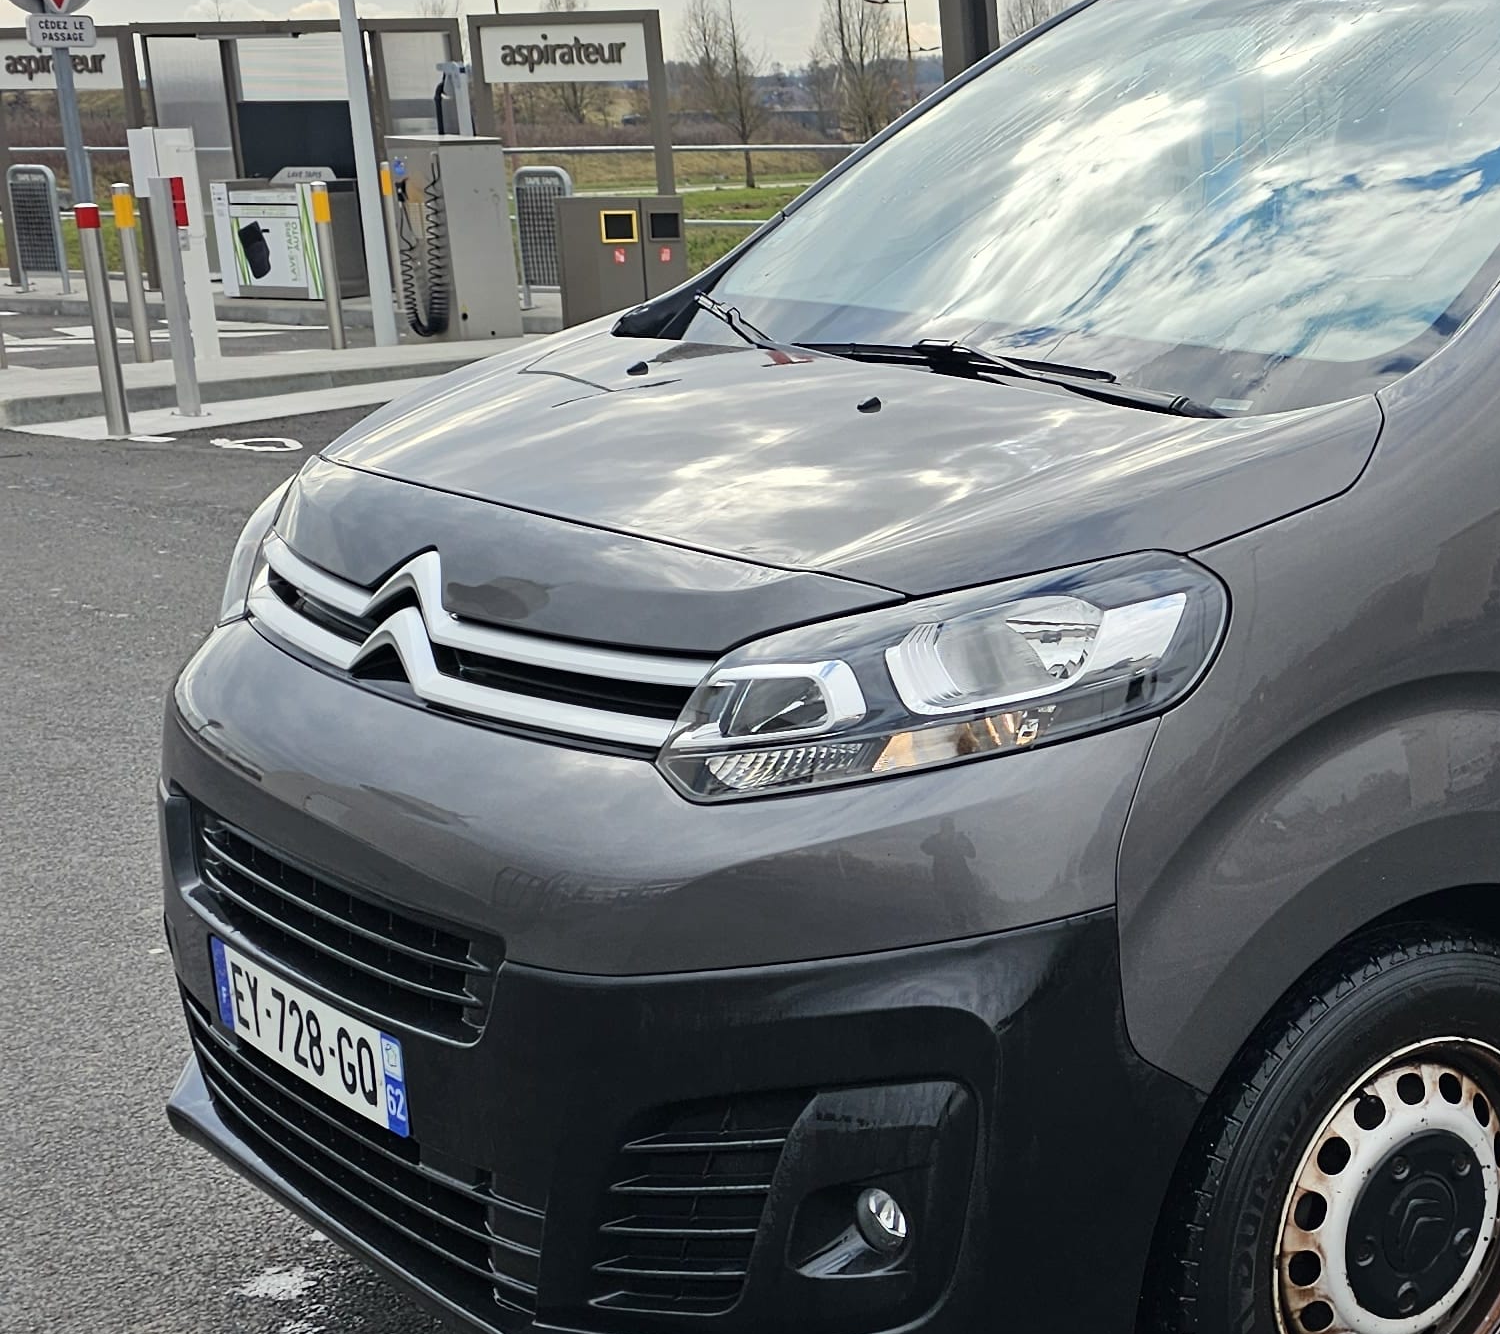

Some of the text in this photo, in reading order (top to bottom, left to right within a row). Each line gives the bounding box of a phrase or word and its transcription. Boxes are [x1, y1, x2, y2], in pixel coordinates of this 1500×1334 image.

[38, 19, 85, 30] CÉDEZ LE
[42, 32, 85, 42] PASSAGE
[5, 48, 106, 81] aspireur
[501, 33, 626, 73] aspirateur
[231, 960, 378, 1107] EY-728-GQ
[386, 1084, 406, 1121] 62
